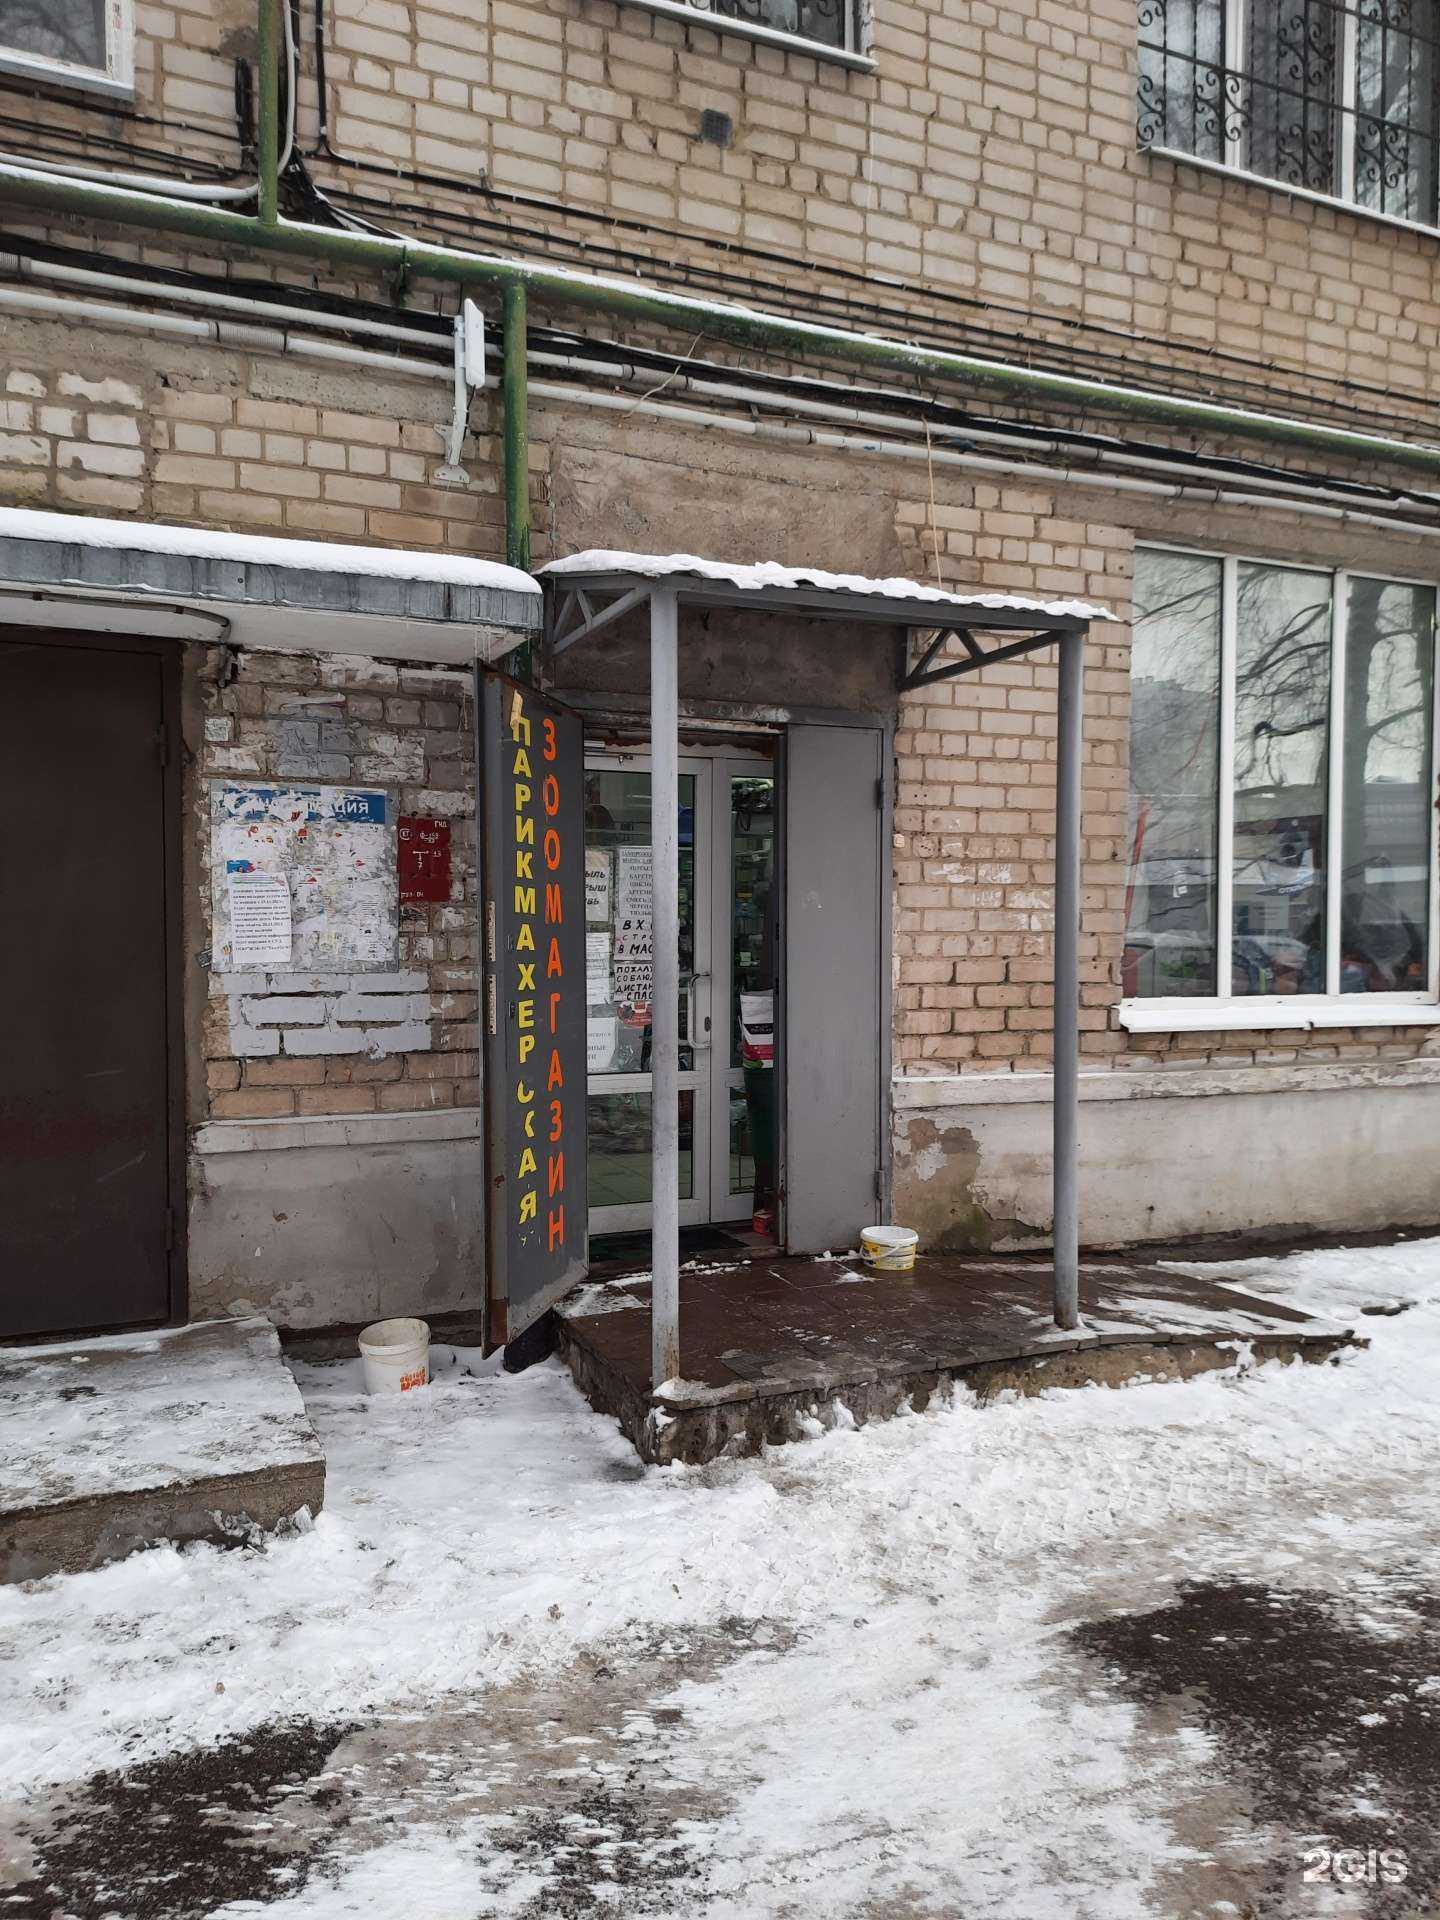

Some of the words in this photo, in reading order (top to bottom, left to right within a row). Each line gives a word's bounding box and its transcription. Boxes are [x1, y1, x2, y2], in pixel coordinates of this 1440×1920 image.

[585, 870, 605, 878] ЫЛЬ
[622, 919, 653, 930] ВХ
[618, 944, 625, 954] В
[616, 974, 653, 983] СОБЛЮ
[541, 717, 564, 1253] ЗООМАГАЗИН
